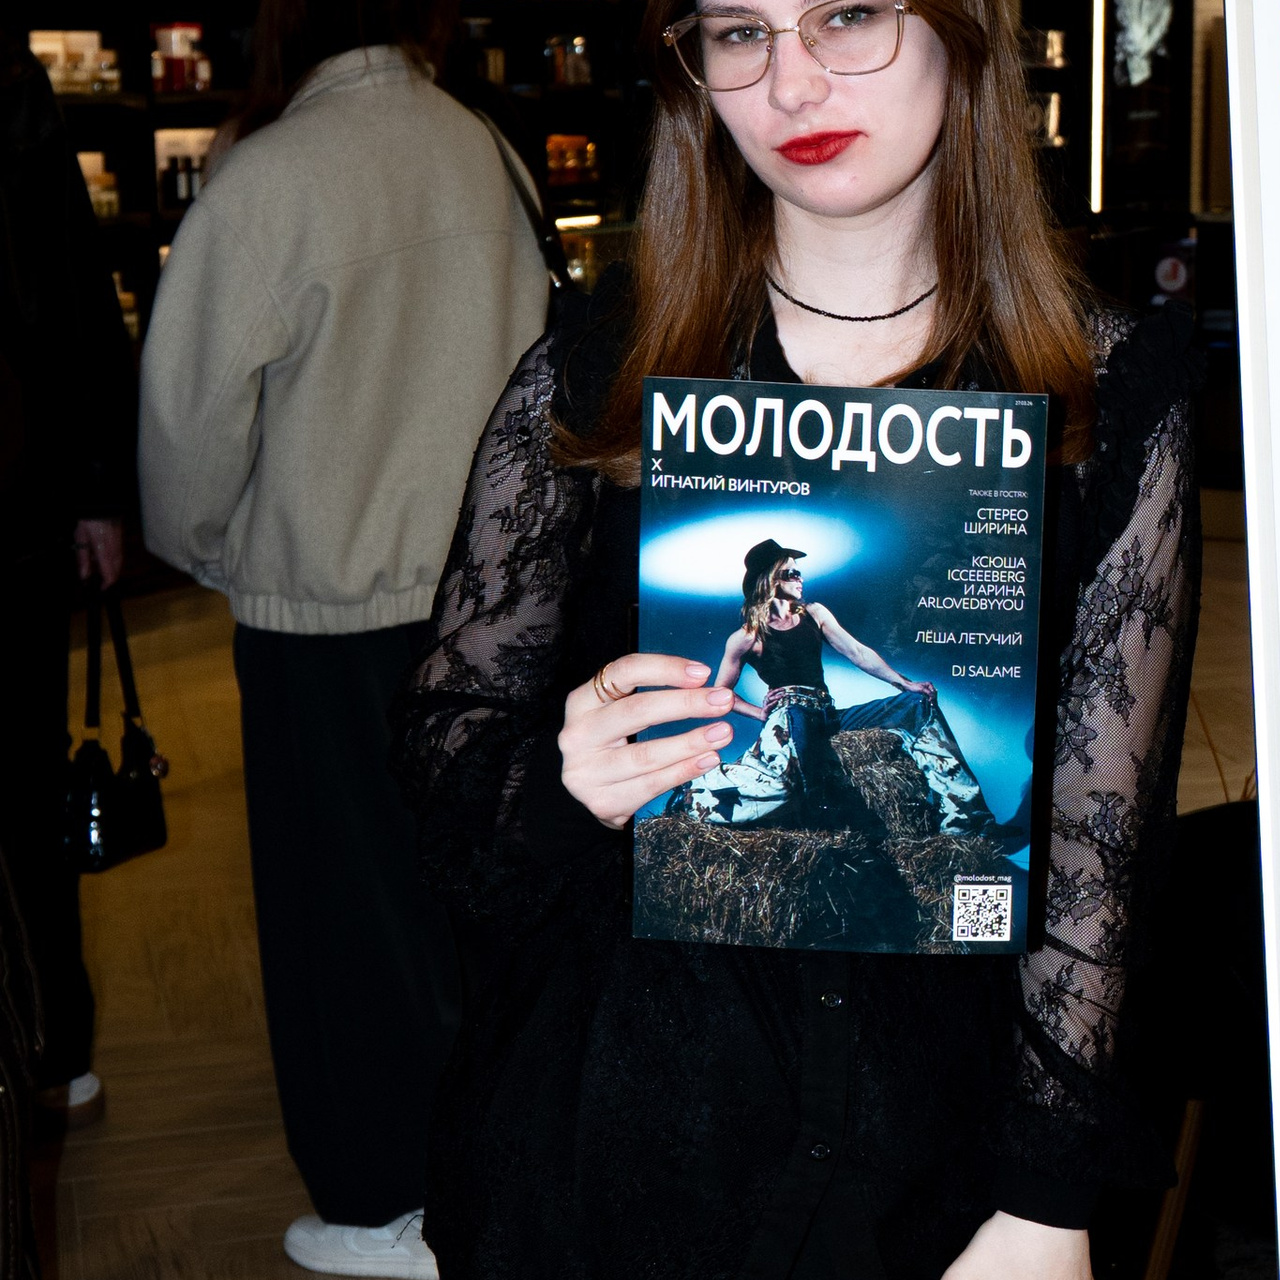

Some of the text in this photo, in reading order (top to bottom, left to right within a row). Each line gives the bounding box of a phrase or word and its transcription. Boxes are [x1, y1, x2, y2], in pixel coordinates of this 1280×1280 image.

[651, 391, 1032, 472] МОЛОДОСТЬ
[651, 474, 810, 496] ИГНАТИЙ ВИНТУРОВ
[968, 489, 993, 498] ТАКЖЕ
[993, 490, 999, 498] В
[976, 507, 1029, 522] СТЕРЕО
[964, 521, 1028, 535] ШИРИНА
[971, 555, 1027, 569] КСЮША
[947, 569, 1026, 583] ICCEEEBERG
[963, 584, 1026, 597] И АРИНА
[917, 596, 1024, 611] ARLOVEDBYYOU
[915, 629, 1023, 646] ЛЁША ЛЕТУЧИЙ
[951, 664, 1022, 678] DJ SALAME
[953, 874, 1012, 883] @molodost_mag
